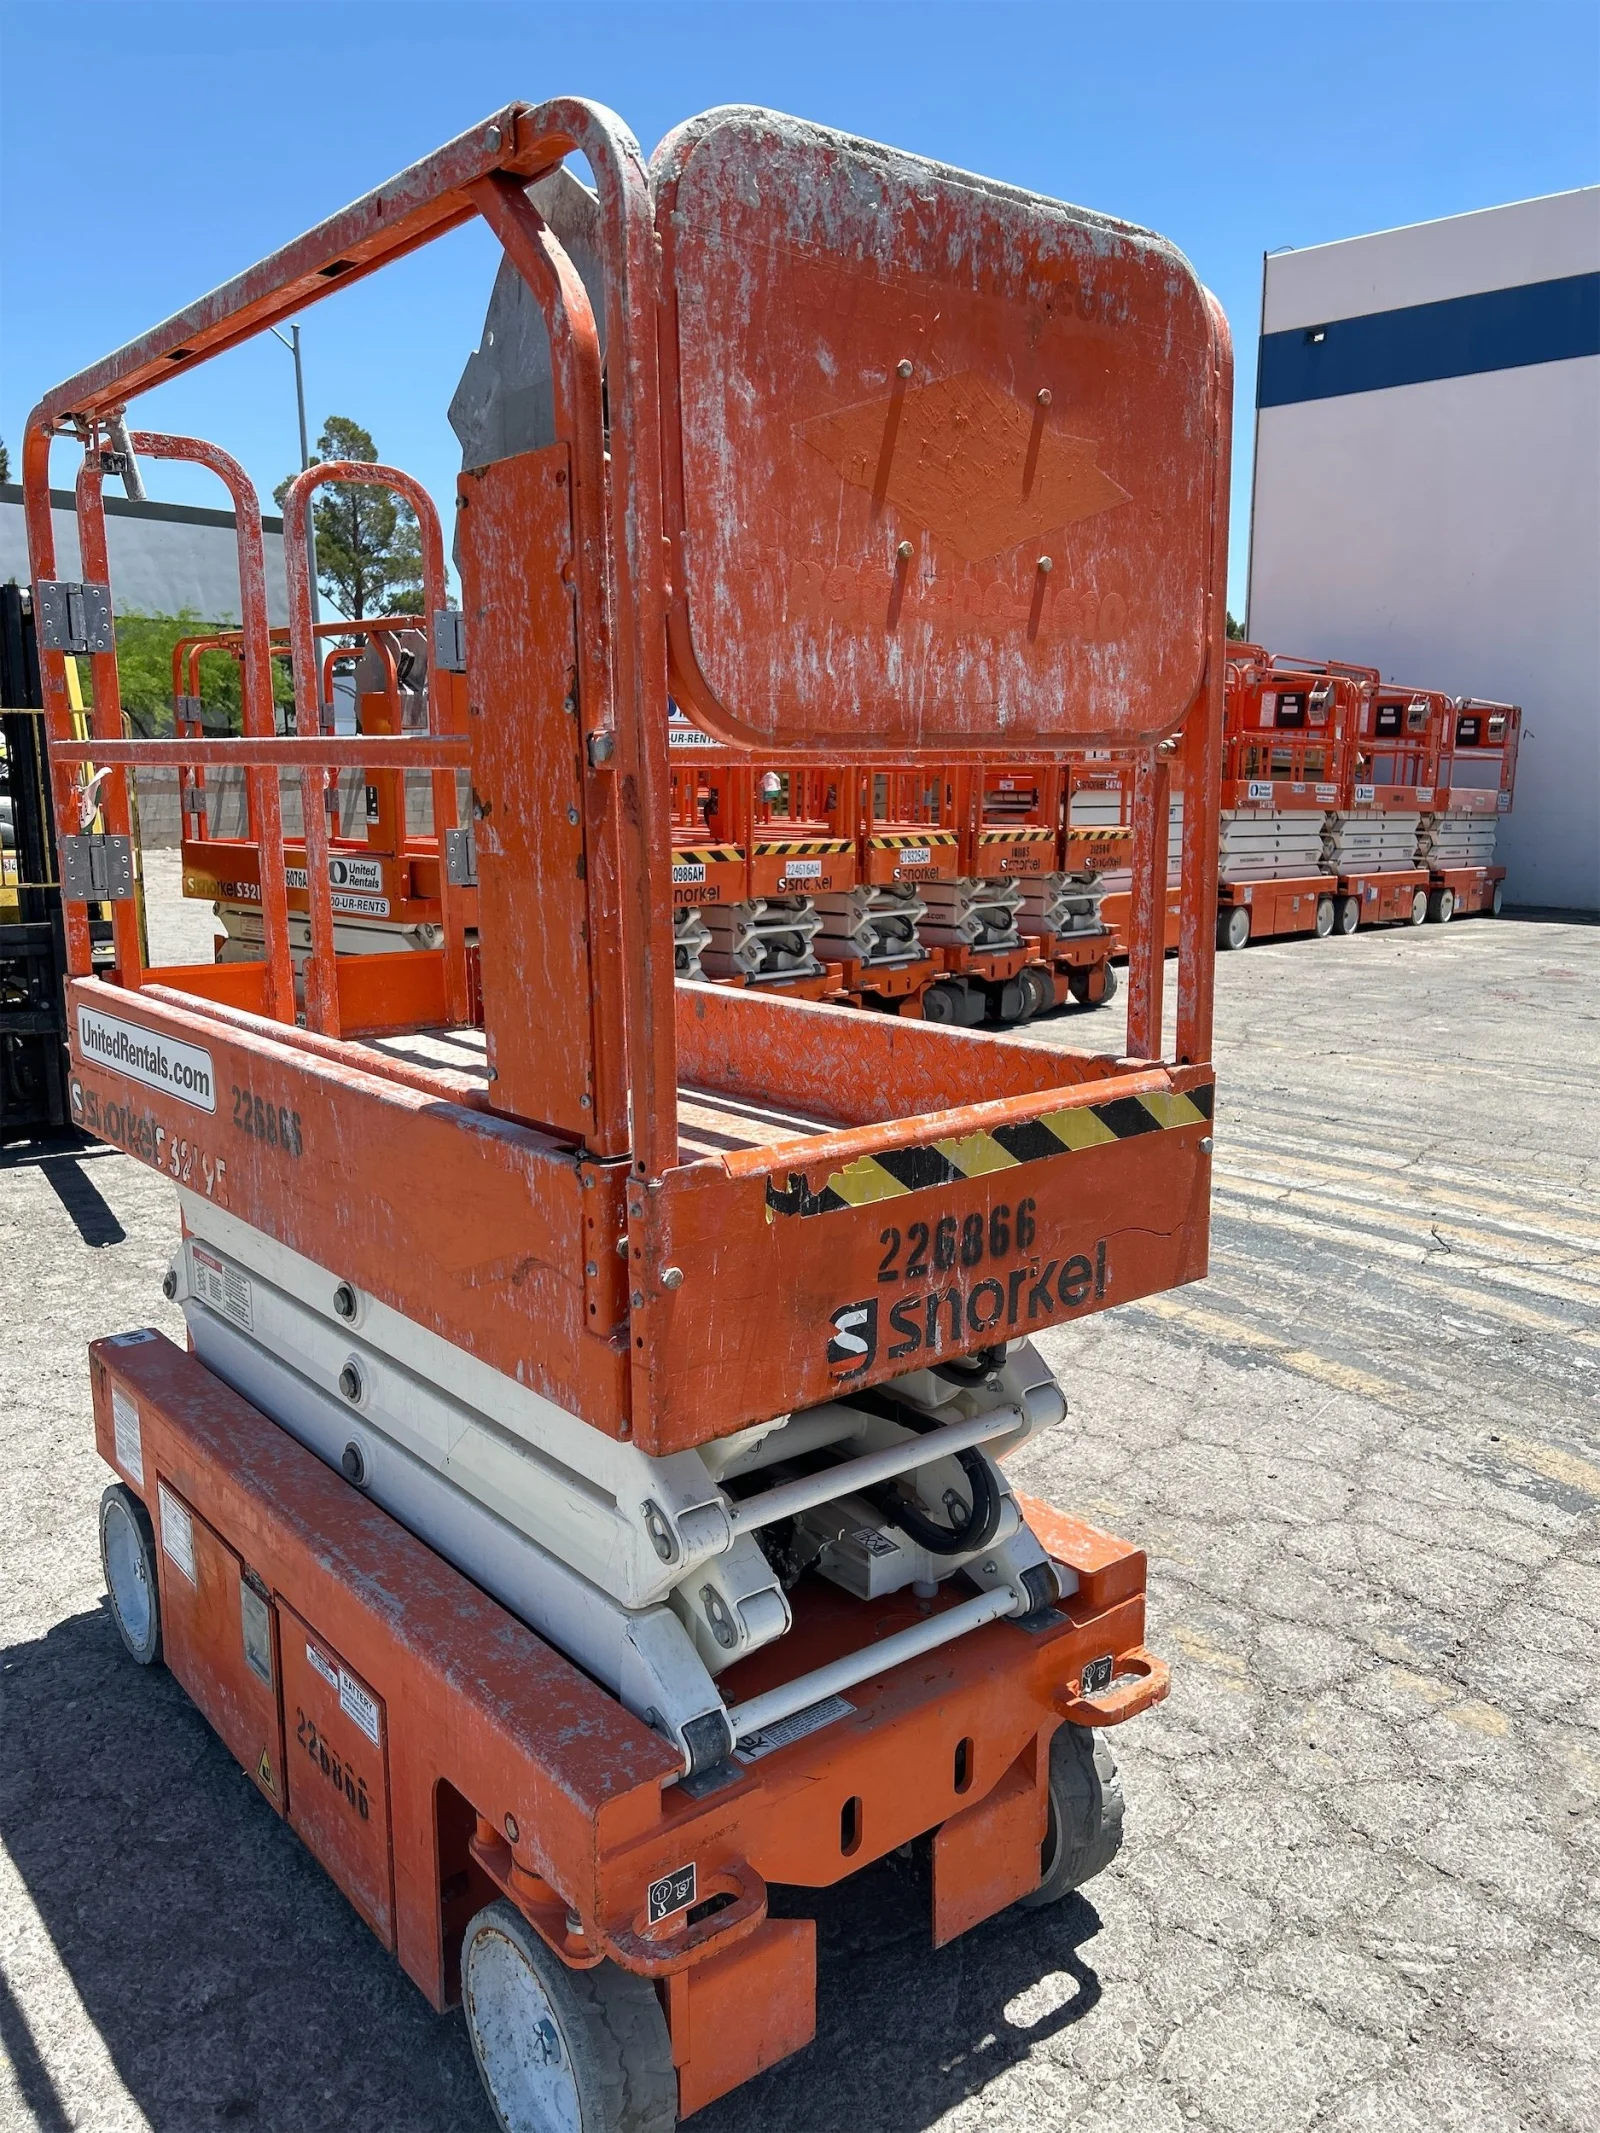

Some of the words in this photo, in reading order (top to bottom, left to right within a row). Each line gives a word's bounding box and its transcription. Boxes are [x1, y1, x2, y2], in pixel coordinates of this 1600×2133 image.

[349, 862, 377, 877] United
[673, 866, 704, 882] 0986AH
[901, 866, 939, 880] snorkel
[349, 875, 380, 889] Rentals
[674, 885, 720, 904] norkel
[81, 1017, 210, 1098] UnitedRentals.com
[876, 1196, 1038, 1284] 226866
[887, 1237, 1107, 1361] snorkel
[343, 1675, 373, 1714] BATTERY
